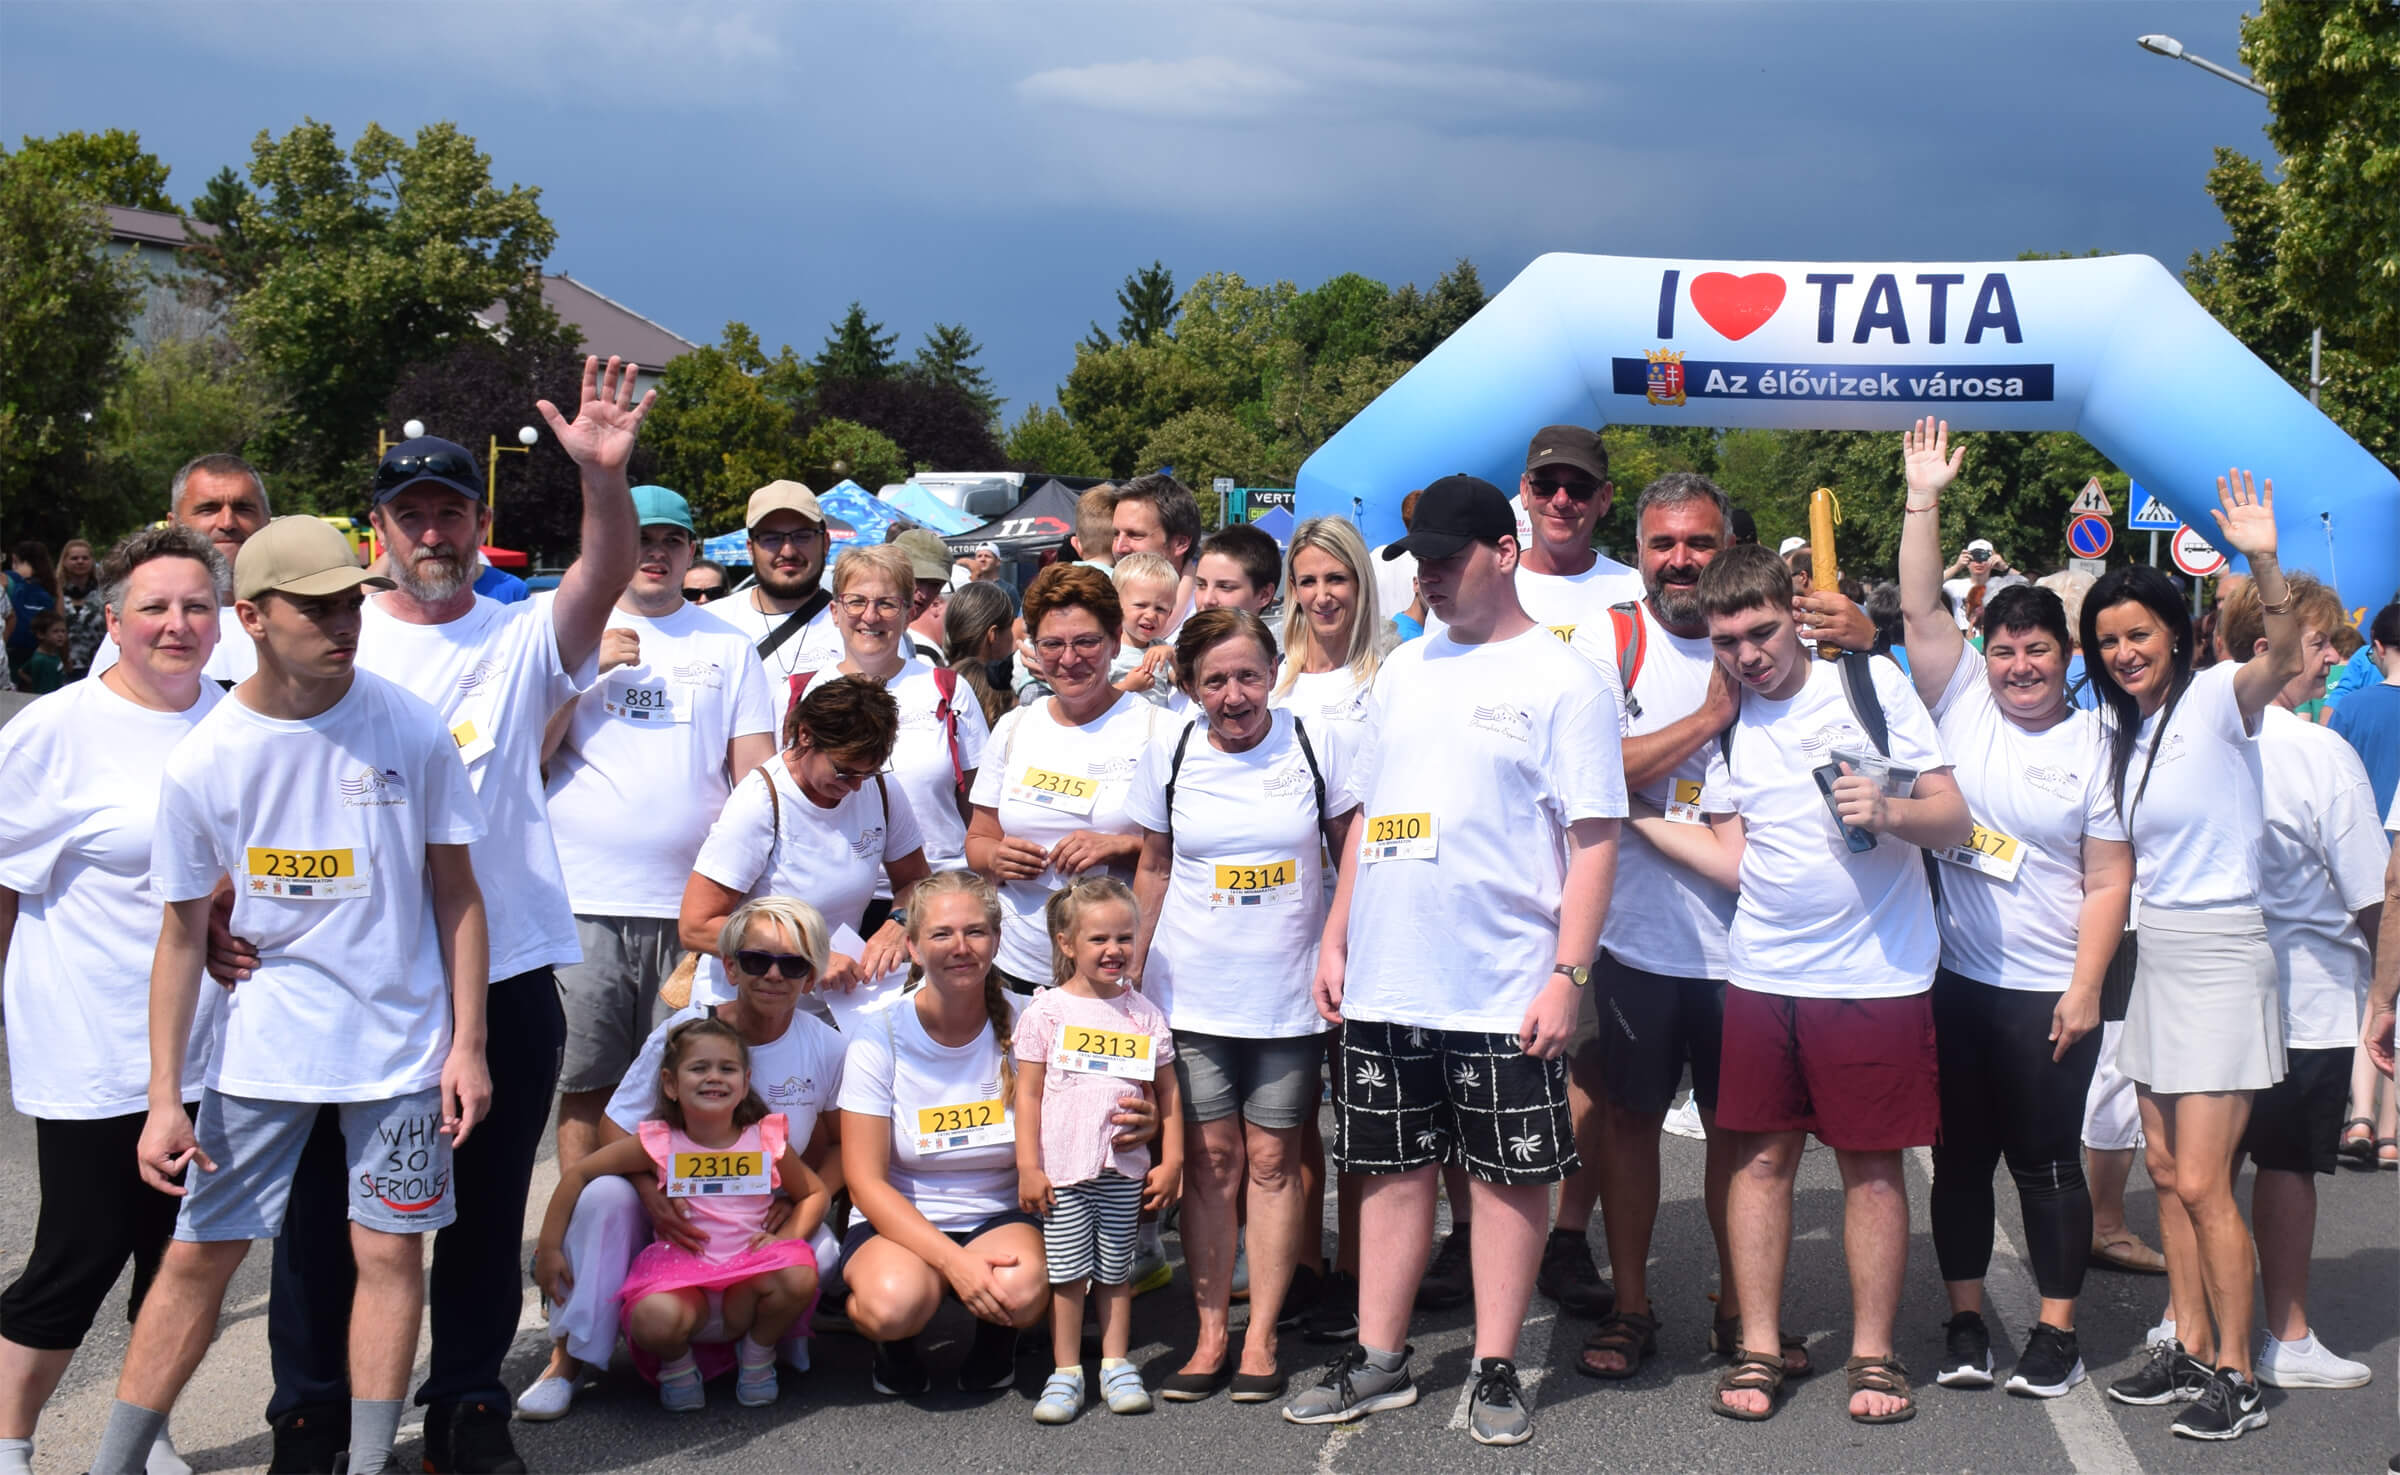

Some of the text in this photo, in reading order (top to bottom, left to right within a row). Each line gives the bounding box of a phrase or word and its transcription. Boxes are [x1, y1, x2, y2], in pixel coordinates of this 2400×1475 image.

[1657, 270, 2024, 344] I TATA
[1705, 368, 2024, 398] Az élővizek városa
[625, 688, 665, 708] 881
[1032, 773, 1087, 798] 2315
[1376, 818, 1420, 842] 2310
[1960, 830, 2006, 856] 317
[265, 854, 339, 879] 2320
[1228, 866, 1286, 890] 2314
[1077, 1032, 1137, 1059] 2313
[377, 1112, 440, 1147] WHY
[933, 1106, 993, 1133] 2312
[389, 1150, 429, 1172] SO
[689, 1156, 751, 1178] 2316
[360, 1168, 449, 1201] SERIOUS
